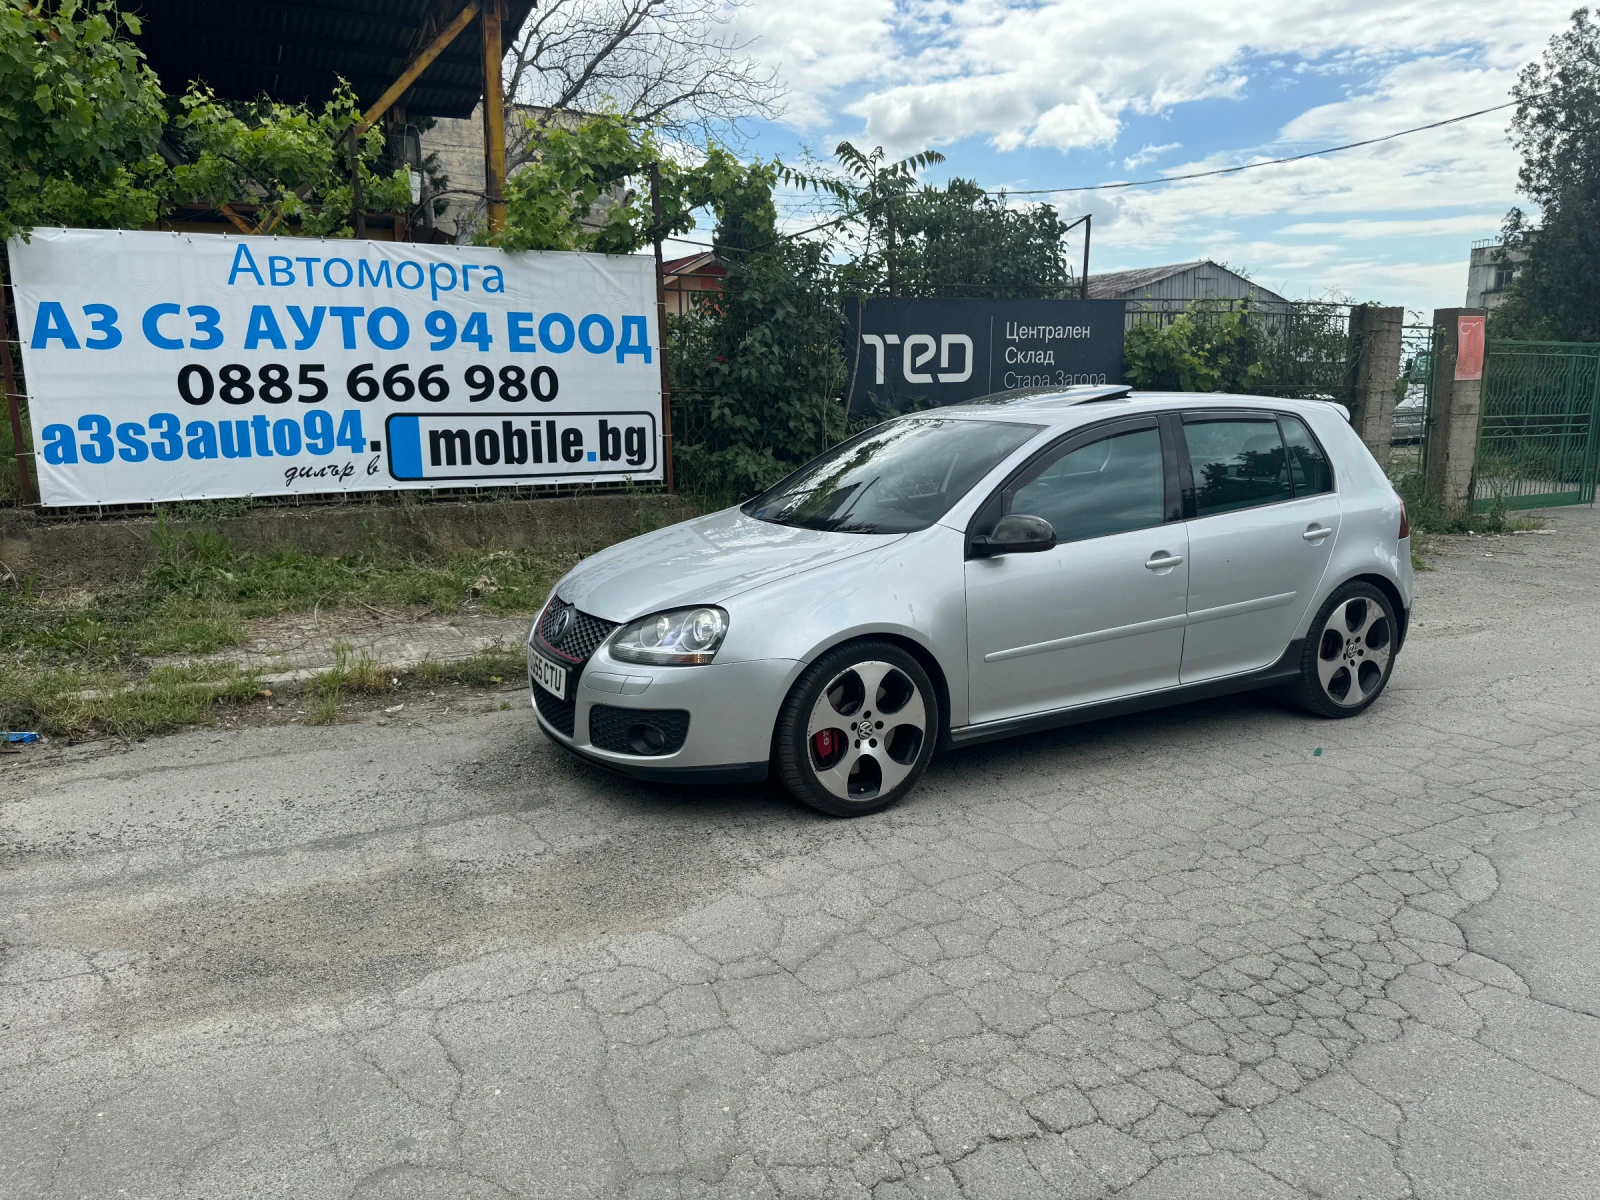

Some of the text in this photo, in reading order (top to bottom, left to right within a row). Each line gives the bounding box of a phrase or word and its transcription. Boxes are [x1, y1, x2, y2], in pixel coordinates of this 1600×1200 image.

[228, 243, 505, 303] Автоморга
[244, 305, 410, 352] АУТО
[424, 310, 493, 353] 94
[507, 312, 652, 365] ЕООД
[1006, 321, 1091, 341] Централен
[1005, 346, 1055, 366] Склад
[178, 363, 559, 405] 0885 666 980
[429, 419, 646, 467] mobile.bg
[284, 461, 356, 487] дилър
[544, 661, 562, 691] CTU
